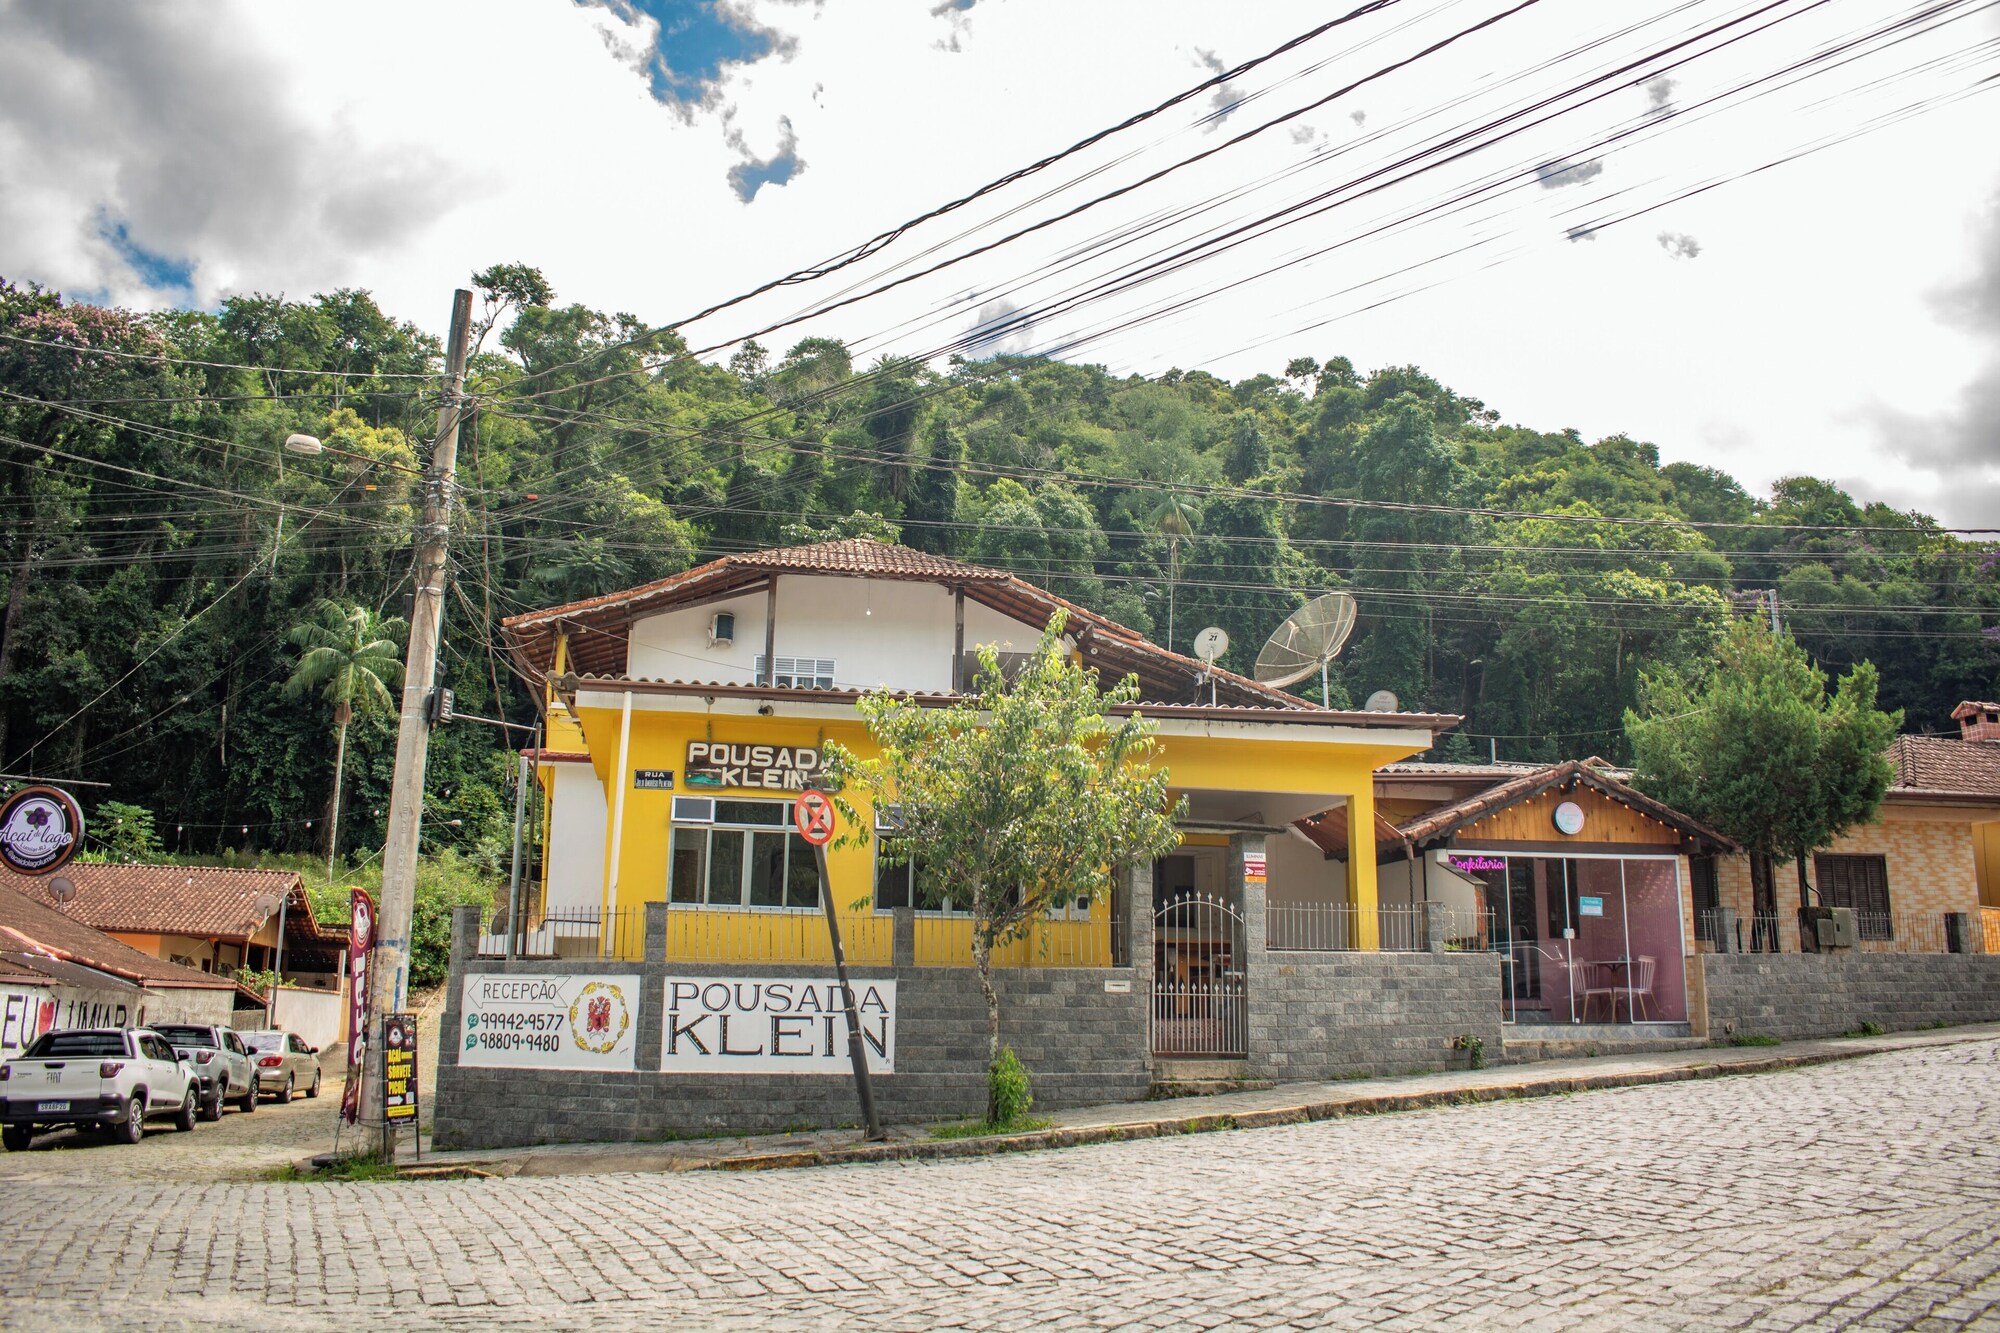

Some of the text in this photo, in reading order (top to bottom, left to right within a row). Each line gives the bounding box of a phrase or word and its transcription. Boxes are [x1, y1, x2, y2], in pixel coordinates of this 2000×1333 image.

[721, 766, 808, 789] KLEIN
[40, 825, 72, 849] lago
[483, 979, 557, 1001] RECEPÇÃO
[668, 982, 890, 1013] POUSADA
[2, 994, 39, 1049] EU
[468, 1016, 478, 1024] 22
[467, 1036, 477, 1045] 22
[667, 1014, 890, 1058] KLEIN
[46, 1072, 62, 1083] FIAT
[388, 1064, 412, 1079] SORVETE
[388, 1078, 407, 1095] PICOLÉ
